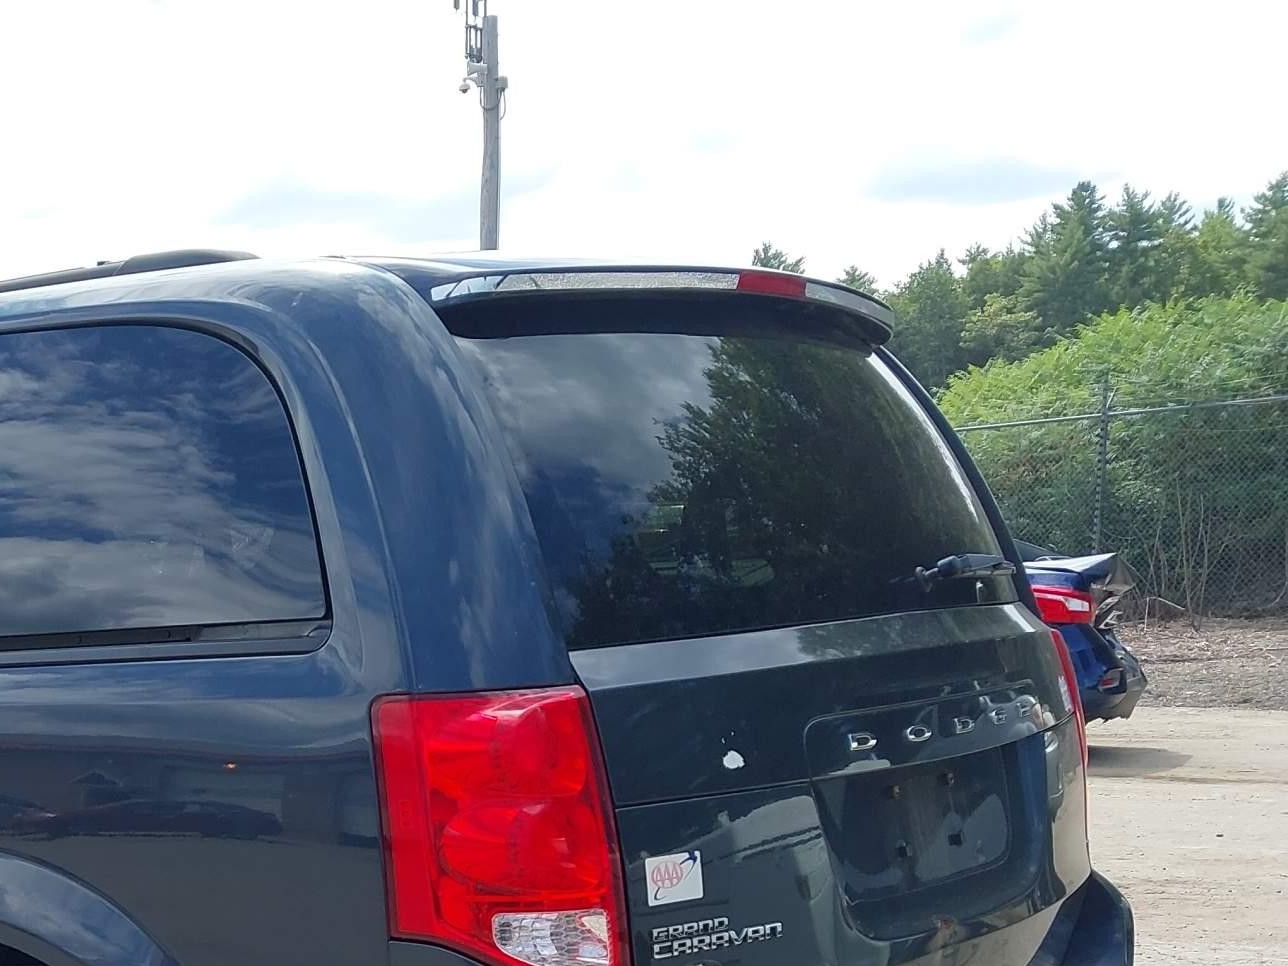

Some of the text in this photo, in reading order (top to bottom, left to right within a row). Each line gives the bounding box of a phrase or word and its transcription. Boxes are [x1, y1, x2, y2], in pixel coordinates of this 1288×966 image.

[847, 699, 1037, 752] DODGE
[653, 862, 681, 883] AAA
[652, 917, 729, 943] GRAND
[653, 922, 783, 959] CARAVAN
